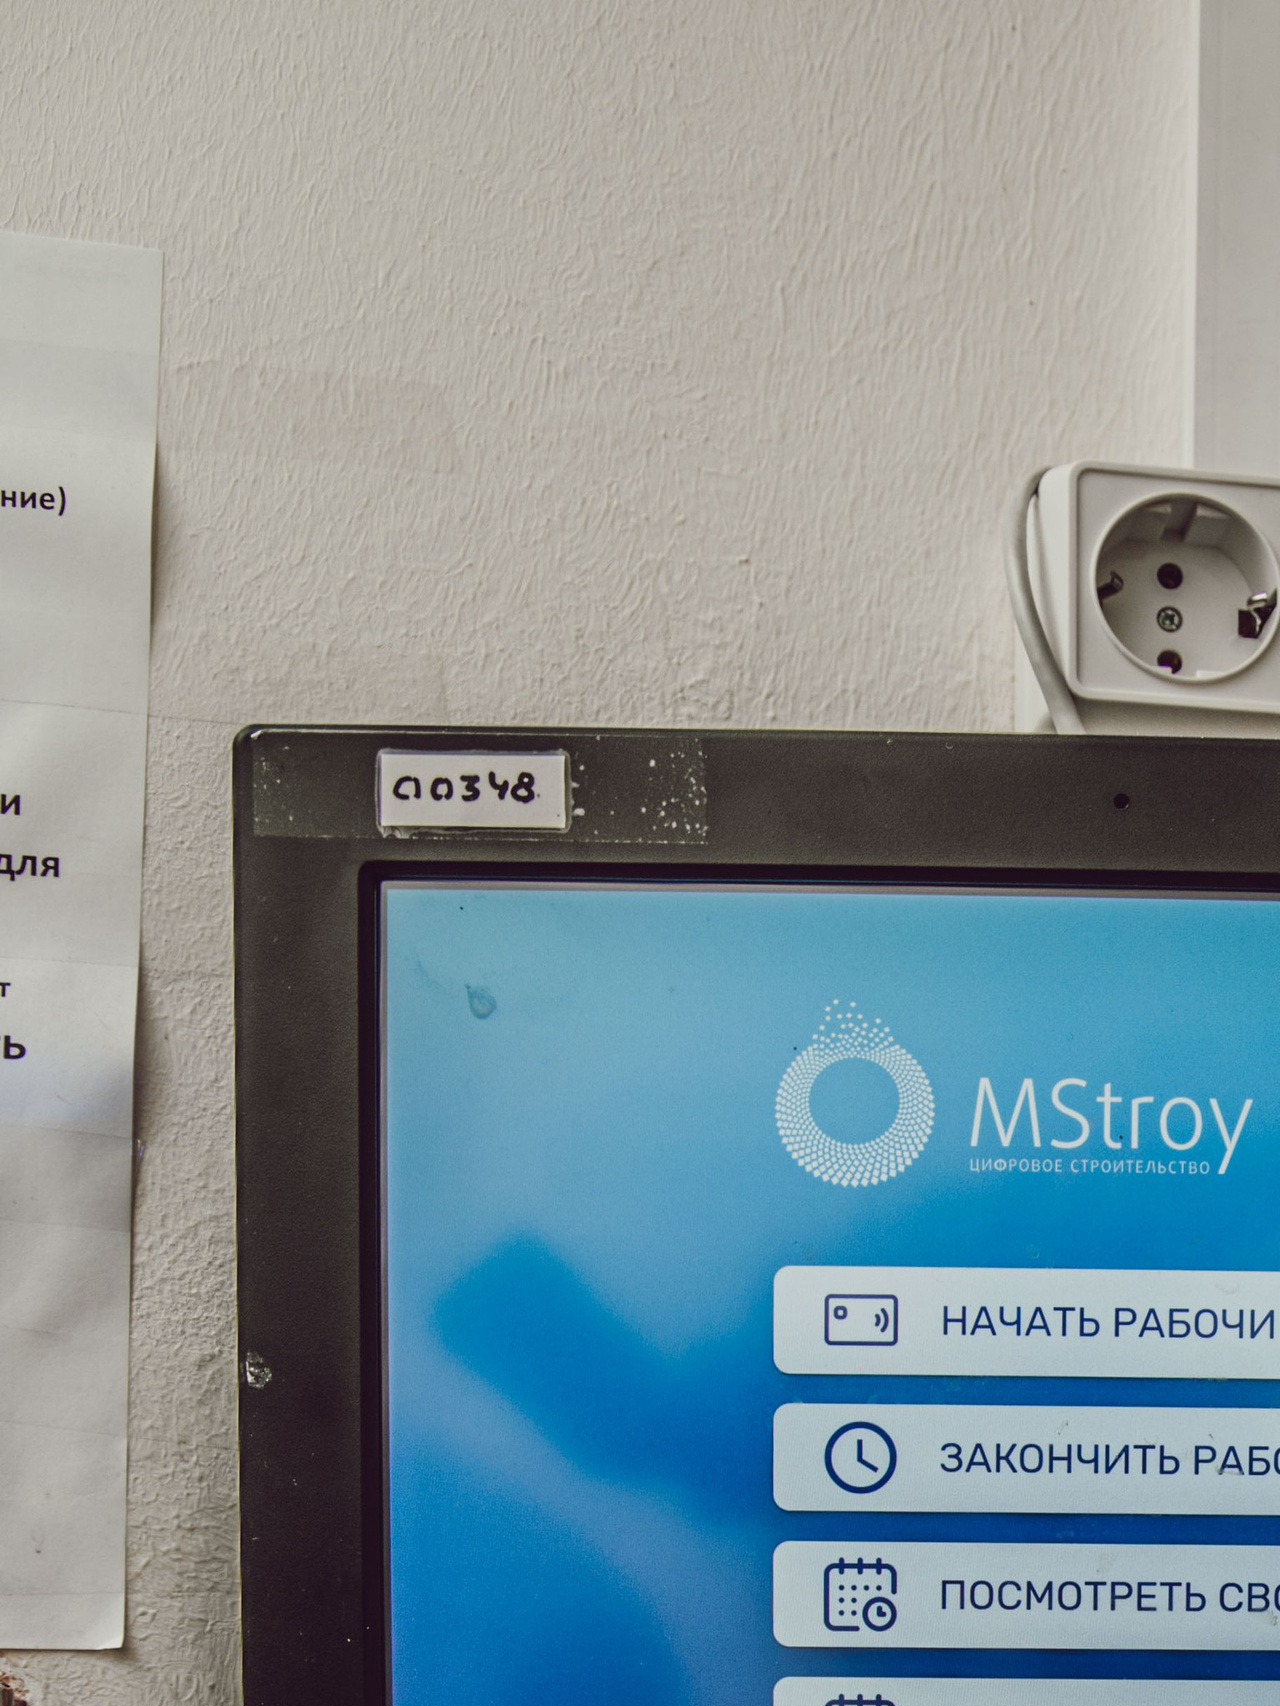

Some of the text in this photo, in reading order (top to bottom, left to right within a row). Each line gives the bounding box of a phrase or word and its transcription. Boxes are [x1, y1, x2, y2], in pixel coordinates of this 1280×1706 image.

[0, 486, 66, 516] ние)
[969, 1076, 1254, 1176] MStroy
[969, 1157, 1211, 1176] ЦИФРОВОЕ СТРОИТЕЛЬСТВО
[941, 1306, 1101, 1338] НАЧАТЬ
[940, 1442, 1181, 1476] ЗАКОНЧИТЬ
[940, 1579, 1207, 1613] ПОСМОТРЕТЬ
